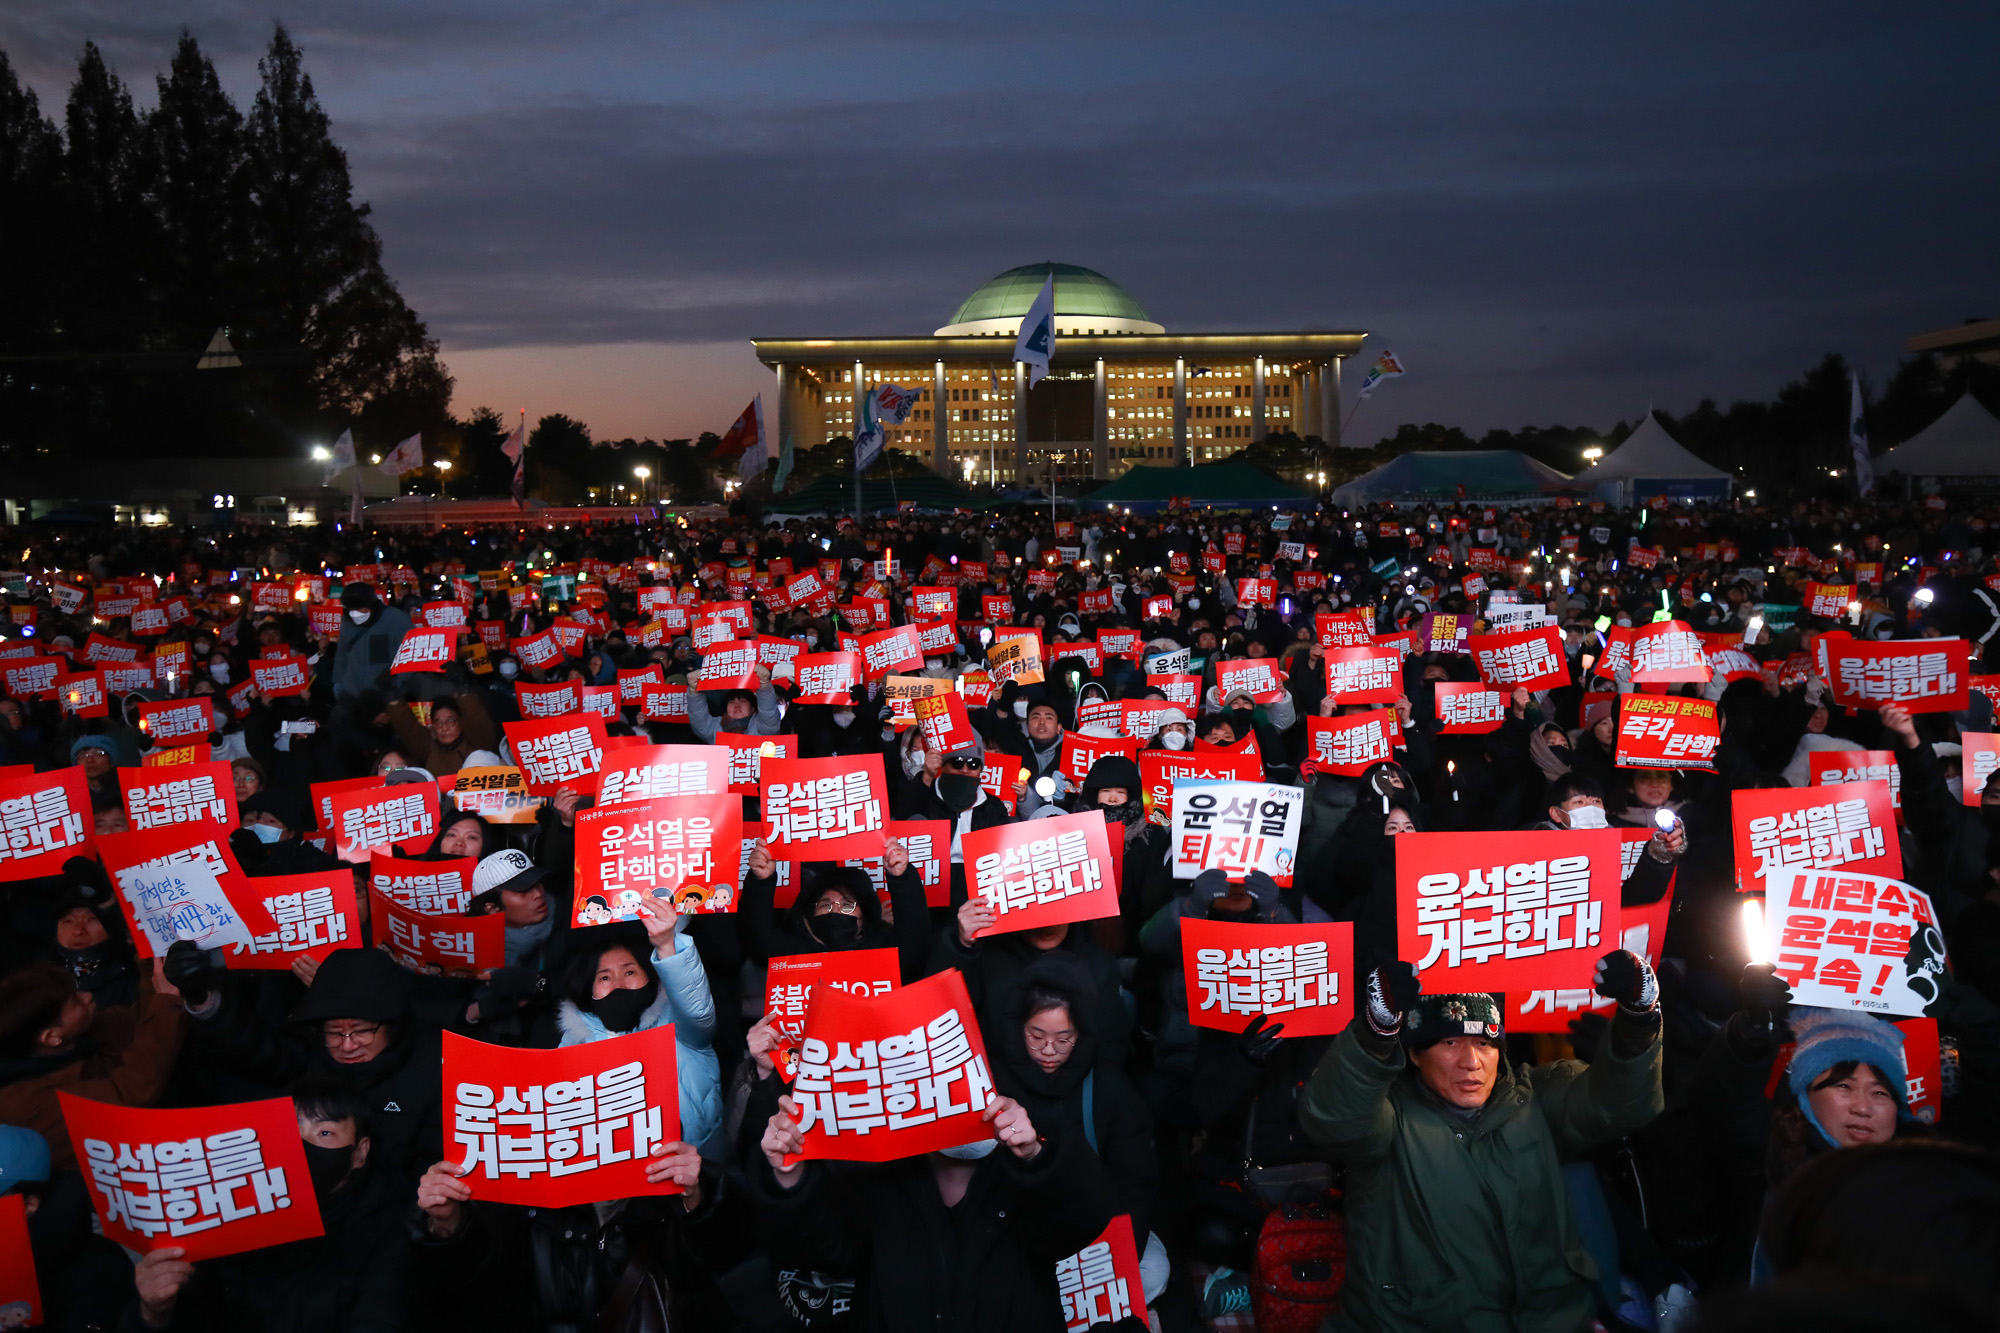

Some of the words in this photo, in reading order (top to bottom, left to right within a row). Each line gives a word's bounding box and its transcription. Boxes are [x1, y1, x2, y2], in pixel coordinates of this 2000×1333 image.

[1172, 554, 1188, 567] 탄핵
[1203, 555, 1220, 569] 탄핵
[788, 574, 816, 594] 윤석열을
[1298, 575, 1317, 586] 탄핵
[1815, 585, 1849, 597] 내란죄
[916, 592, 951, 603] 윤석열을
[1084, 593, 1108, 608] 탄핵
[1246, 585, 1272, 600] 탄핵
[1813, 595, 1848, 608] 윤석열
[425, 606, 463, 620] 윤석열을
[653, 609, 684, 620] 윤석열을
[917, 601, 954, 614] 거부다!
[988, 601, 1011, 616] 탄핵
[1492, 610, 1533, 624] 내란죄로
[694, 623, 731, 636] 윤석열을
[1327, 622, 1365, 634] 내란수괴
[1433, 615, 1458, 627] 퇴진
[516, 635, 551, 652] 윤석열을
[643, 629, 663, 642] 윤석열
[1100, 634, 1134, 645] 윤석열을
[1322, 633, 1353, 647] 윤석열
[1354, 634, 1371, 645] 체포
[1431, 627, 1468, 640] 광장을
[1633, 631, 1702, 656] 윤석열을
[87, 642, 137, 661] 윤석열을
[523, 645, 558, 665] 거부한다!
[760, 643, 799, 656] 윤석열을
[864, 632, 911, 661] 윤석열을
[990, 644, 1021, 668] 윤석열을
[1058, 648, 1097, 660] 윤석열을
[1430, 639, 1459, 652] 열자!
[1478, 638, 1547, 666] 윤석열을
[156, 652, 186, 668] 윤석열
[868, 644, 917, 674] 거부한다!
[1154, 653, 1190, 674] 윤석열
[1329, 657, 1399, 679] 채상병특검
[1483, 653, 1560, 684] 거부한다!
[1839, 652, 1948, 679] 윤석열을
[6, 663, 58, 682] 윤석열을
[104, 669, 151, 683] 윤석열을
[254, 663, 299, 681] 윤석열을
[619, 672, 657, 686] 윤석열을
[700, 662, 748, 681] 추진하라!
[800, 664, 851, 684] 윤석열을
[994, 655, 1041, 686] 탄핵하라
[1221, 665, 1271, 686] 윤석열을
[58, 678, 97, 697] 윤석열을
[258, 674, 305, 692] 거부한다!
[885, 684, 935, 698] 윤석열을
[1330, 673, 1393, 694] 추진하라!
[1841, 672, 1957, 702] 거부한다!
[61, 691, 102, 713] 거한다!
[521, 687, 573, 704] 윤석열을
[1442, 691, 1501, 710] 윤석열을
[146, 705, 203, 728] 윤석열을
[525, 698, 578, 717] 거부한다!
[1442, 704, 1505, 727] 거부한다!
[1623, 698, 1680, 715] 내란수괴
[1680, 702, 1714, 719] 윤석열
[151, 718, 209, 740] 거부한다!
[917, 715, 953, 738] 윤석열
[1315, 719, 1382, 749] 윤석열을
[1621, 715, 1675, 741] 즉각
[516, 726, 594, 762] 윤석열을
[1317, 737, 1389, 766] 거부한다!
[1662, 733, 1721, 758] 탄핵!
[151, 745, 195, 767] 내란죄
[455, 773, 522, 792] 윤석열을
[599, 760, 708, 806] 윤석열을
[767, 770, 872, 815] 윤석열을
[128, 775, 217, 814] 윤석열을
[343, 794, 425, 832] 윤석열을
[605, 804, 652, 817] www.nanum.com
[766, 799, 883, 844] 거부한다!
[1183, 795, 1290, 838] 윤석열
[349, 812, 433, 851] 거부한다!
[1749, 798, 1871, 850] 윤석열을
[599, 816, 714, 857] 윤석열을
[975, 829, 1089, 887] 윤석열을
[1178, 833, 1265, 873] 퇴진!
[1752, 825, 1887, 879] 거부한다!
[600, 850, 715, 891] 탄핵하라
[134, 876, 190, 911] 윤석열을
[373, 871, 463, 898] 윤석열을
[978, 858, 1103, 915] 거부한다!
[1416, 855, 1591, 925] 윤석열을
[1788, 874, 1934, 927] 내란수괴
[388, 913, 475, 964] 탄핵
[1416, 900, 1602, 971] 거부한다!
[1780, 914, 1912, 958] 윤석열
[1196, 941, 1329, 983] 윤석열을
[1198, 972, 1339, 1016] 거부한다!
[794, 1007, 973, 1092] 윤석열을
[455, 1060, 647, 1134] 윤석열을
[792, 1052, 998, 1137] 거부한다!
[454, 1105, 664, 1180] 거부한다!
[82, 1127, 267, 1192] 윤석열을
[97, 1166, 293, 1240] 거부한다!
